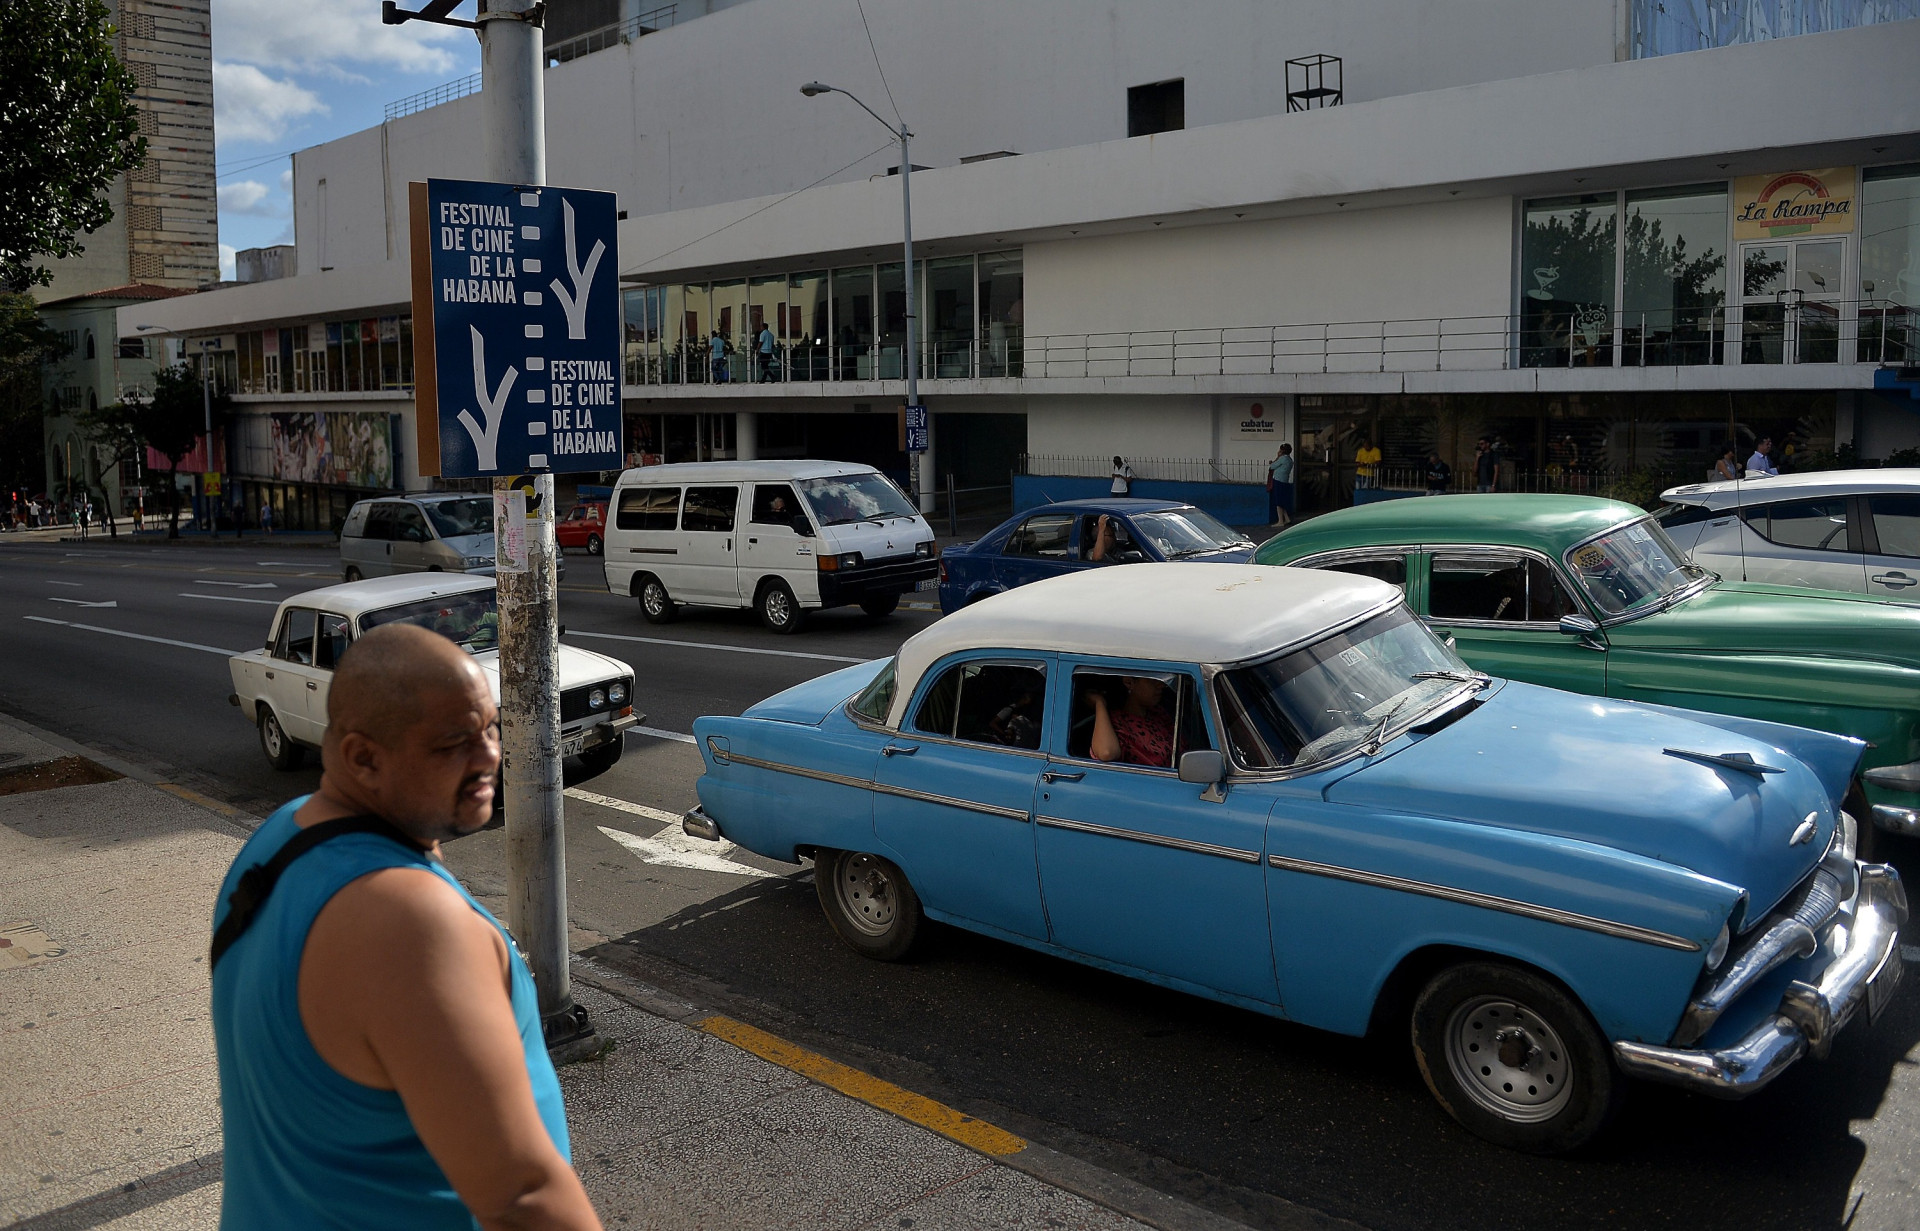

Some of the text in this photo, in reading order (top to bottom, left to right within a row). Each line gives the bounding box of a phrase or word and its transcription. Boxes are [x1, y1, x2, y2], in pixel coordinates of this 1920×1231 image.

[440, 202, 514, 227] FESTIVAL
[1737, 200, 1850, 221] La Rampa
[441, 227, 515, 254] DE CINE
[470, 255, 516, 278] DE LA
[443, 279, 516, 304] HABANA
[551, 360, 614, 381] FESTIVAL
[551, 383, 615, 406] DE CINE
[552, 409, 593, 430] DE LA
[1241, 419, 1274, 427] cubatur
[553, 431, 616, 455] HABANA
[564, 741, 582, 755] 474
